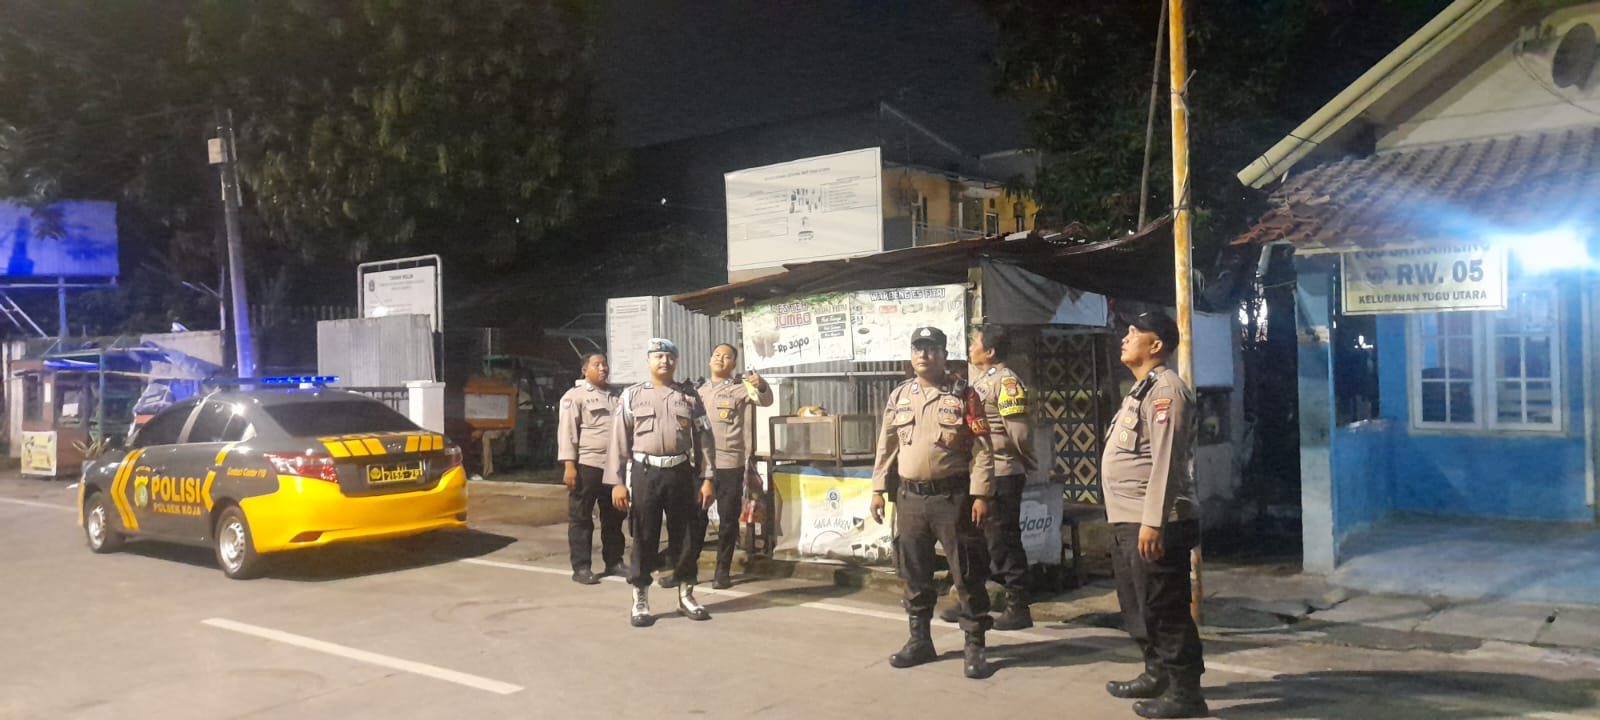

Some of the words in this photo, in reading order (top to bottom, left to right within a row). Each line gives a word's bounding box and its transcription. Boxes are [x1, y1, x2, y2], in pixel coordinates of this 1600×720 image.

[1397, 262, 1444, 285] RW.
[1452, 259, 1484, 283] 05
[1359, 292, 1419, 305] KELURAHAN
[1422, 290, 1450, 302] TUGU
[1453, 289, 1488, 301] UTARA
[776, 311, 812, 328] JUMBO
[777, 343, 788, 353] Rp
[789, 336, 810, 350] 3000
[151, 475, 201, 503] POLISI
[153, 502, 180, 514] POLSEK
[181, 504, 201, 516] KOJA
